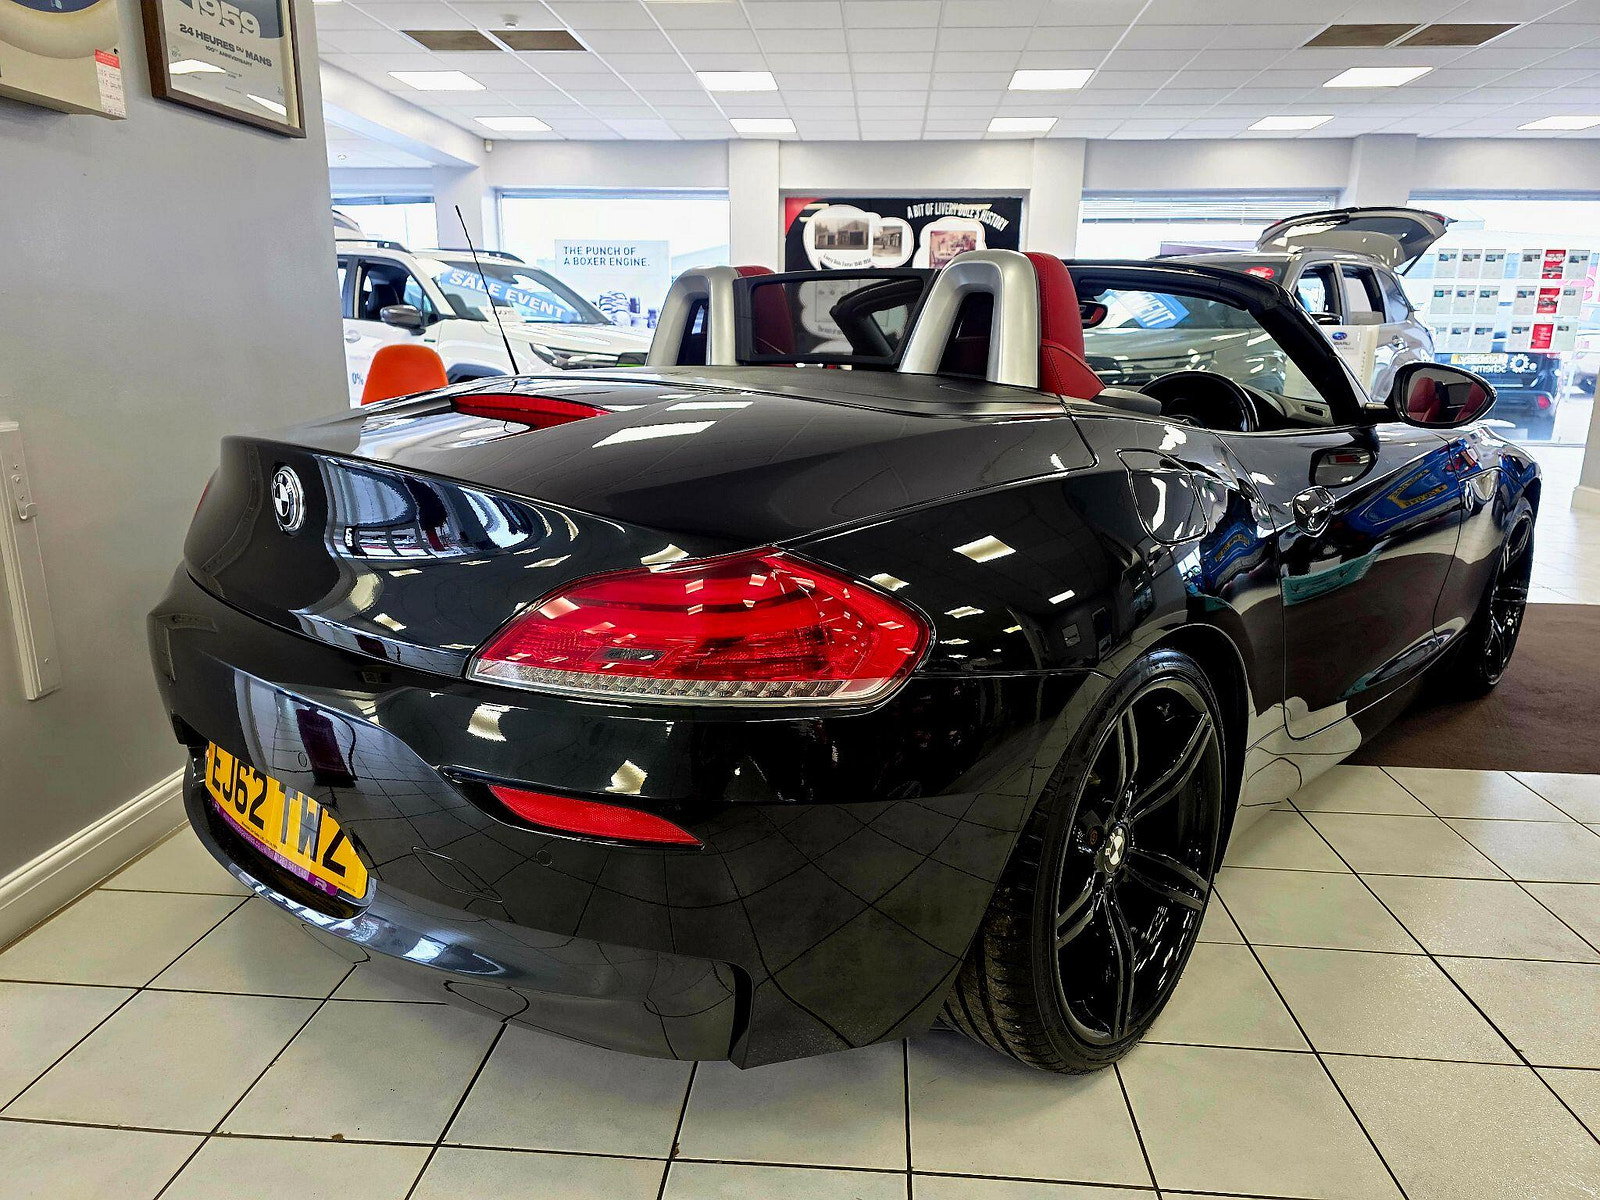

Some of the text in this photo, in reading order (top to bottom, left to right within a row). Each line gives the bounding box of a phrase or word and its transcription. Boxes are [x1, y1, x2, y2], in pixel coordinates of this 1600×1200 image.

[180, 23, 194, 37] 24
[195, 30, 235, 52] HEURES
[245, 49, 272, 67] MANS
[907, 205, 913, 220] A
[913, 204, 925, 218] BIT
[925, 203, 935, 217] OF
[935, 202, 959, 216] LIVERY
[980, 209, 1010, 232] HISTORY
[564, 246, 636, 256] THE PUNCH OF
[564, 257, 650, 267] A BOXER ENGINE.
[449, 271, 567, 319] SALE EVENT
[212, 745, 268, 830] EJ62
